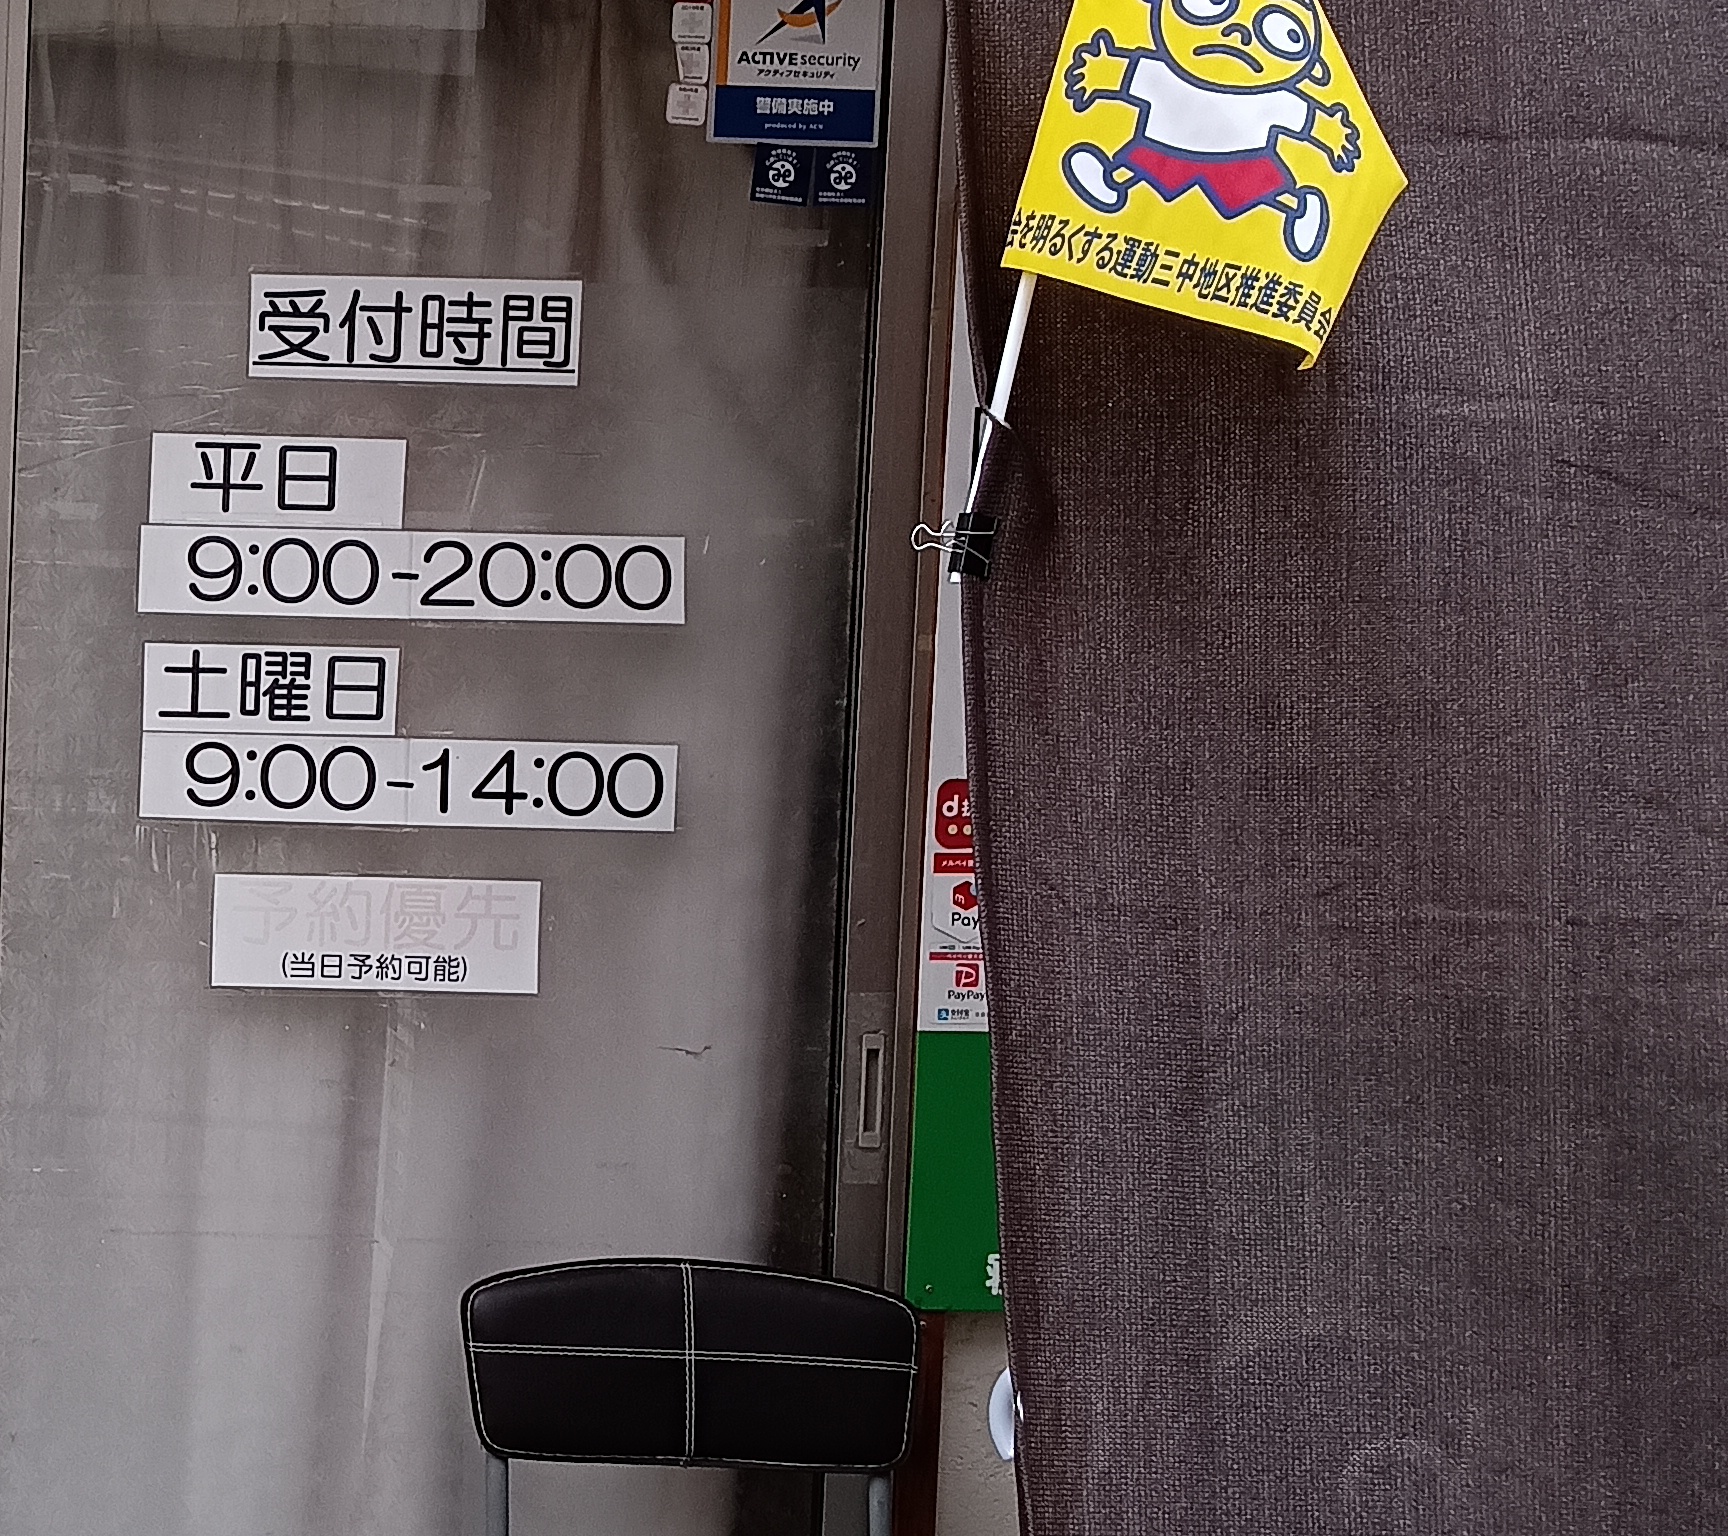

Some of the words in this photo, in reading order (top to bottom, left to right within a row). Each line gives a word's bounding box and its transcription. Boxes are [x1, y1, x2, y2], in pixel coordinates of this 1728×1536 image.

[257, 288, 573, 369] 受付時間
[190, 440, 338, 513] 平日
[186, 534, 672, 611] 9:00-20:00
[158, 649, 387, 723] 土曜日
[185, 741, 665, 819] 9:00-14:00
[233, 879, 520, 953] 予約優先
[281, 952, 468, 983] (当日予約可能)
[947, 989, 986, 1002] PayPay
